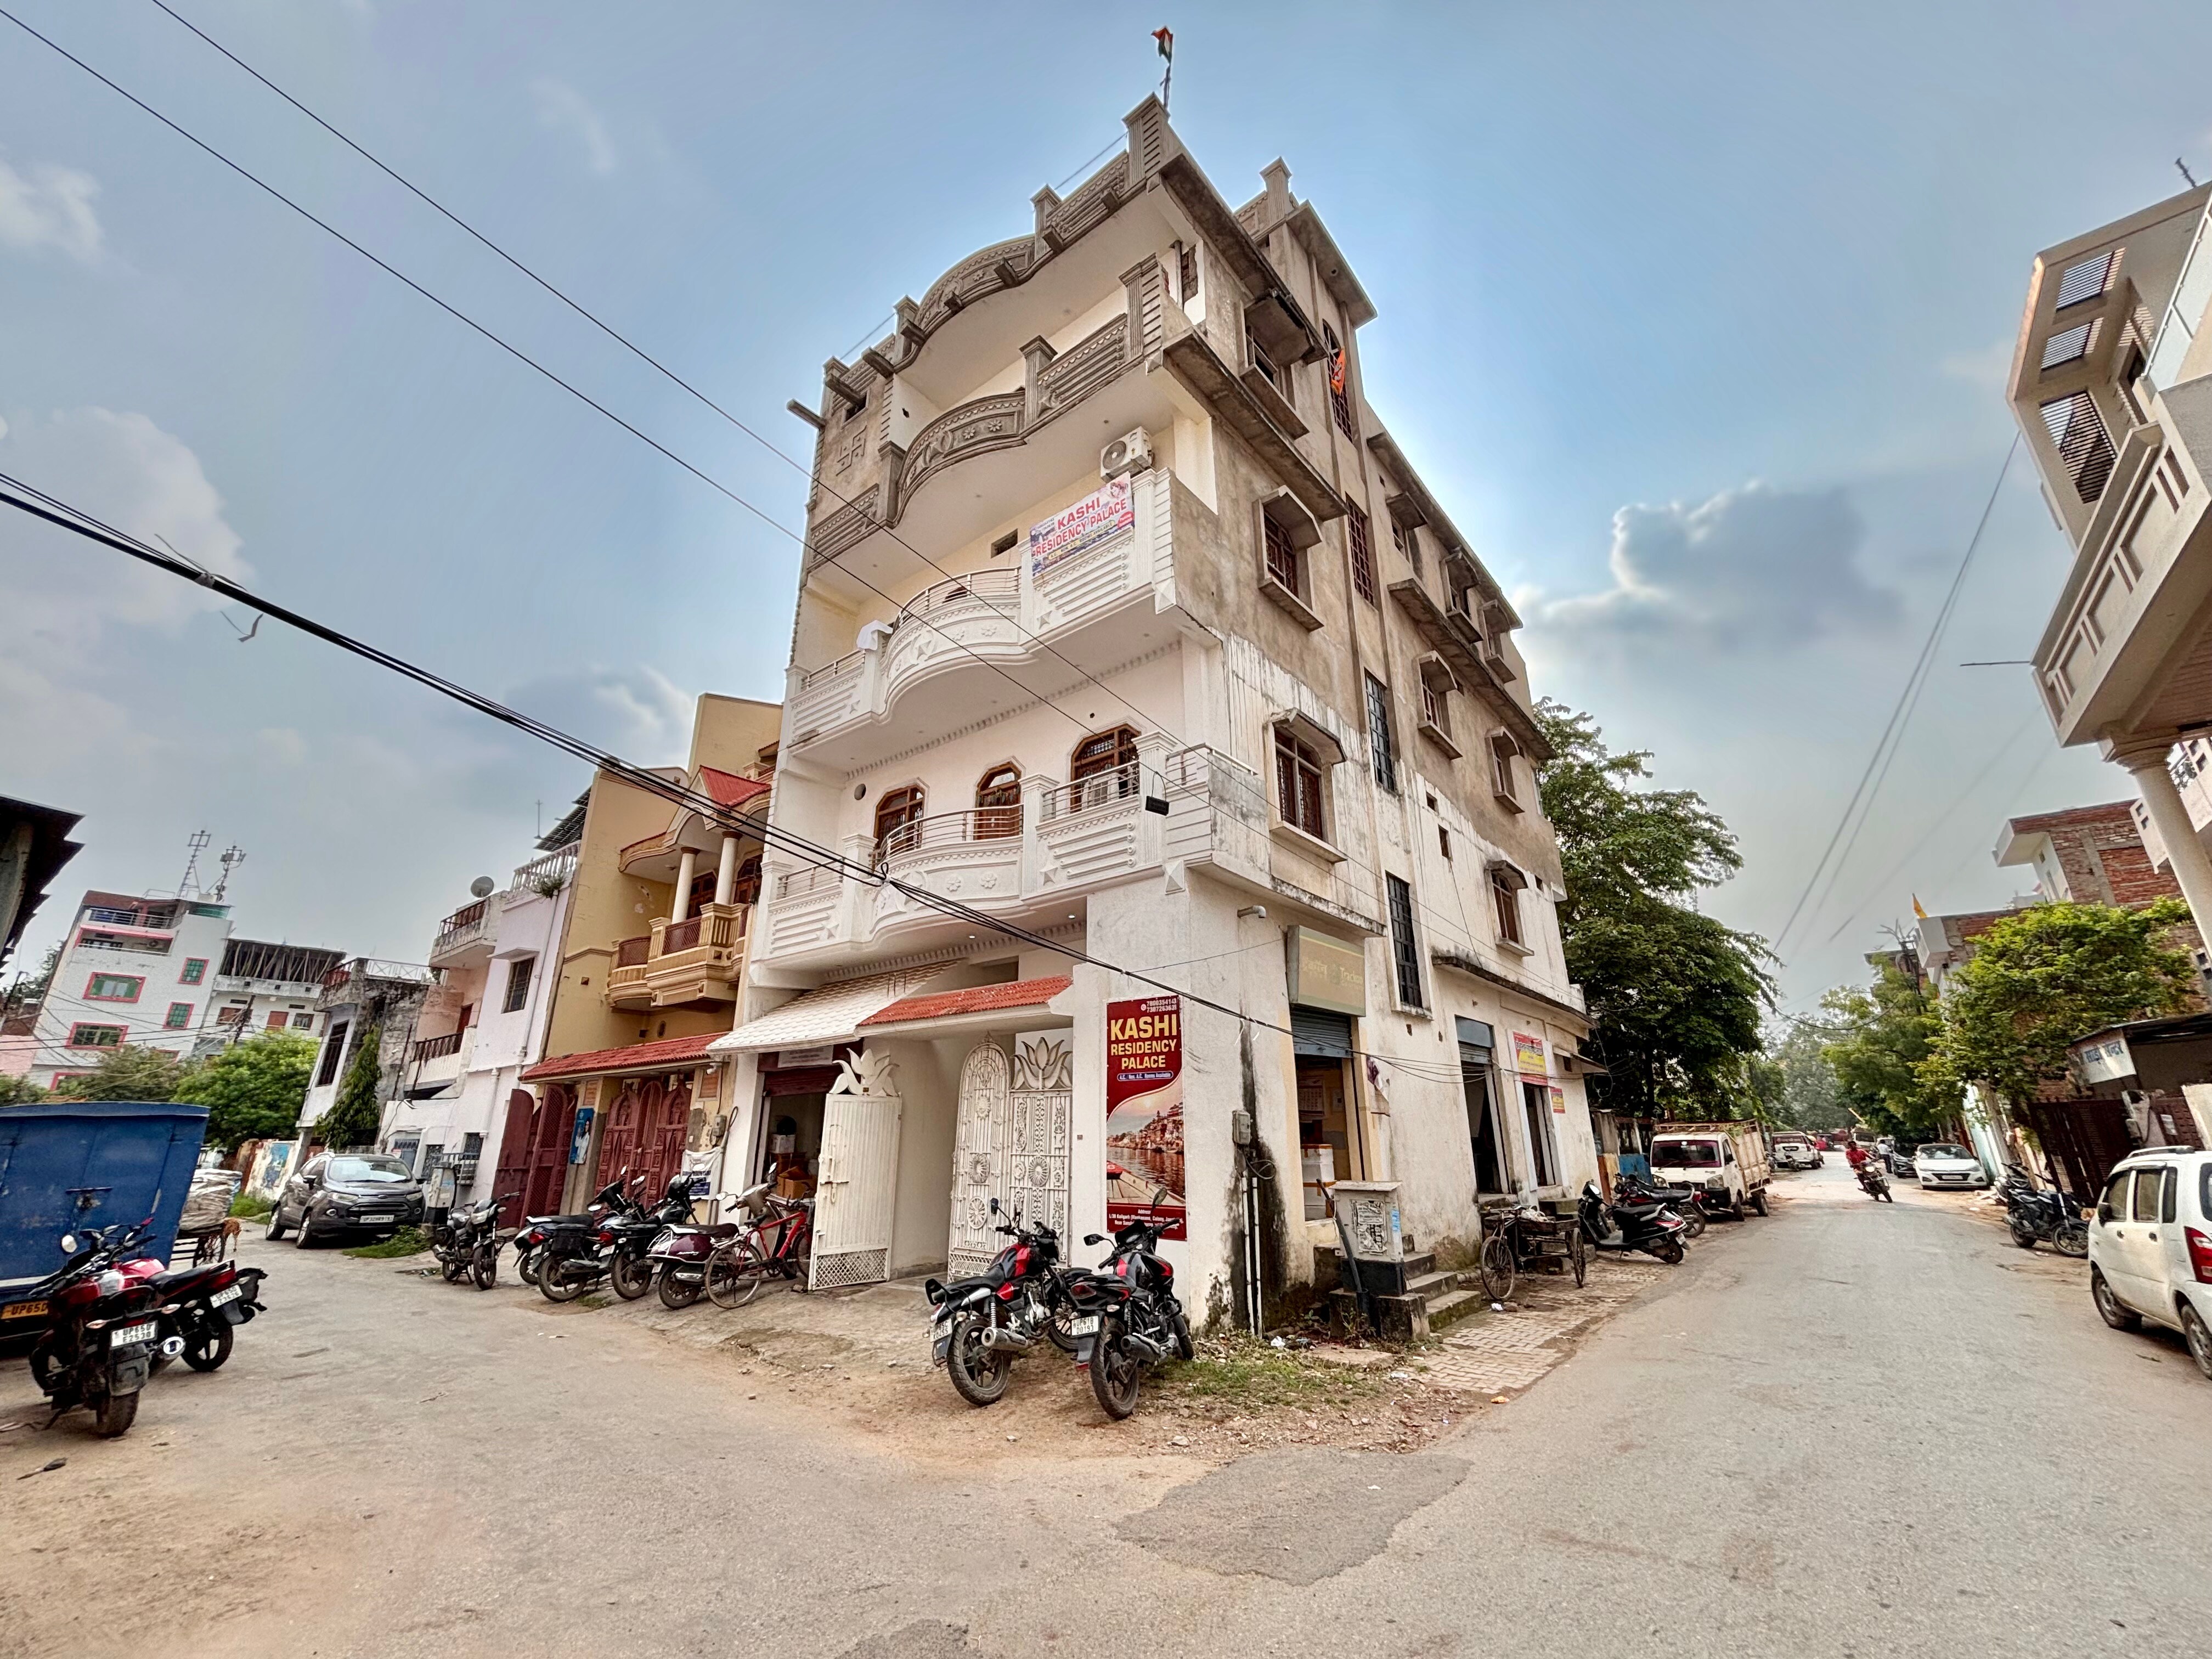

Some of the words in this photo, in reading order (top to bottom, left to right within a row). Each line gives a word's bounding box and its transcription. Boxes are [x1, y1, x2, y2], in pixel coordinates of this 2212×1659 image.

[1057, 497, 1101, 530] KASHI
[1036, 520, 1087, 557] RESIDENCY
[1090, 498, 1127, 527] PALACE
[1110, 1014, 1177, 1041] KASHI
[1111, 1039, 1177, 1056] RESIDENCY
[1121, 1055, 1166, 1070] PALACE
